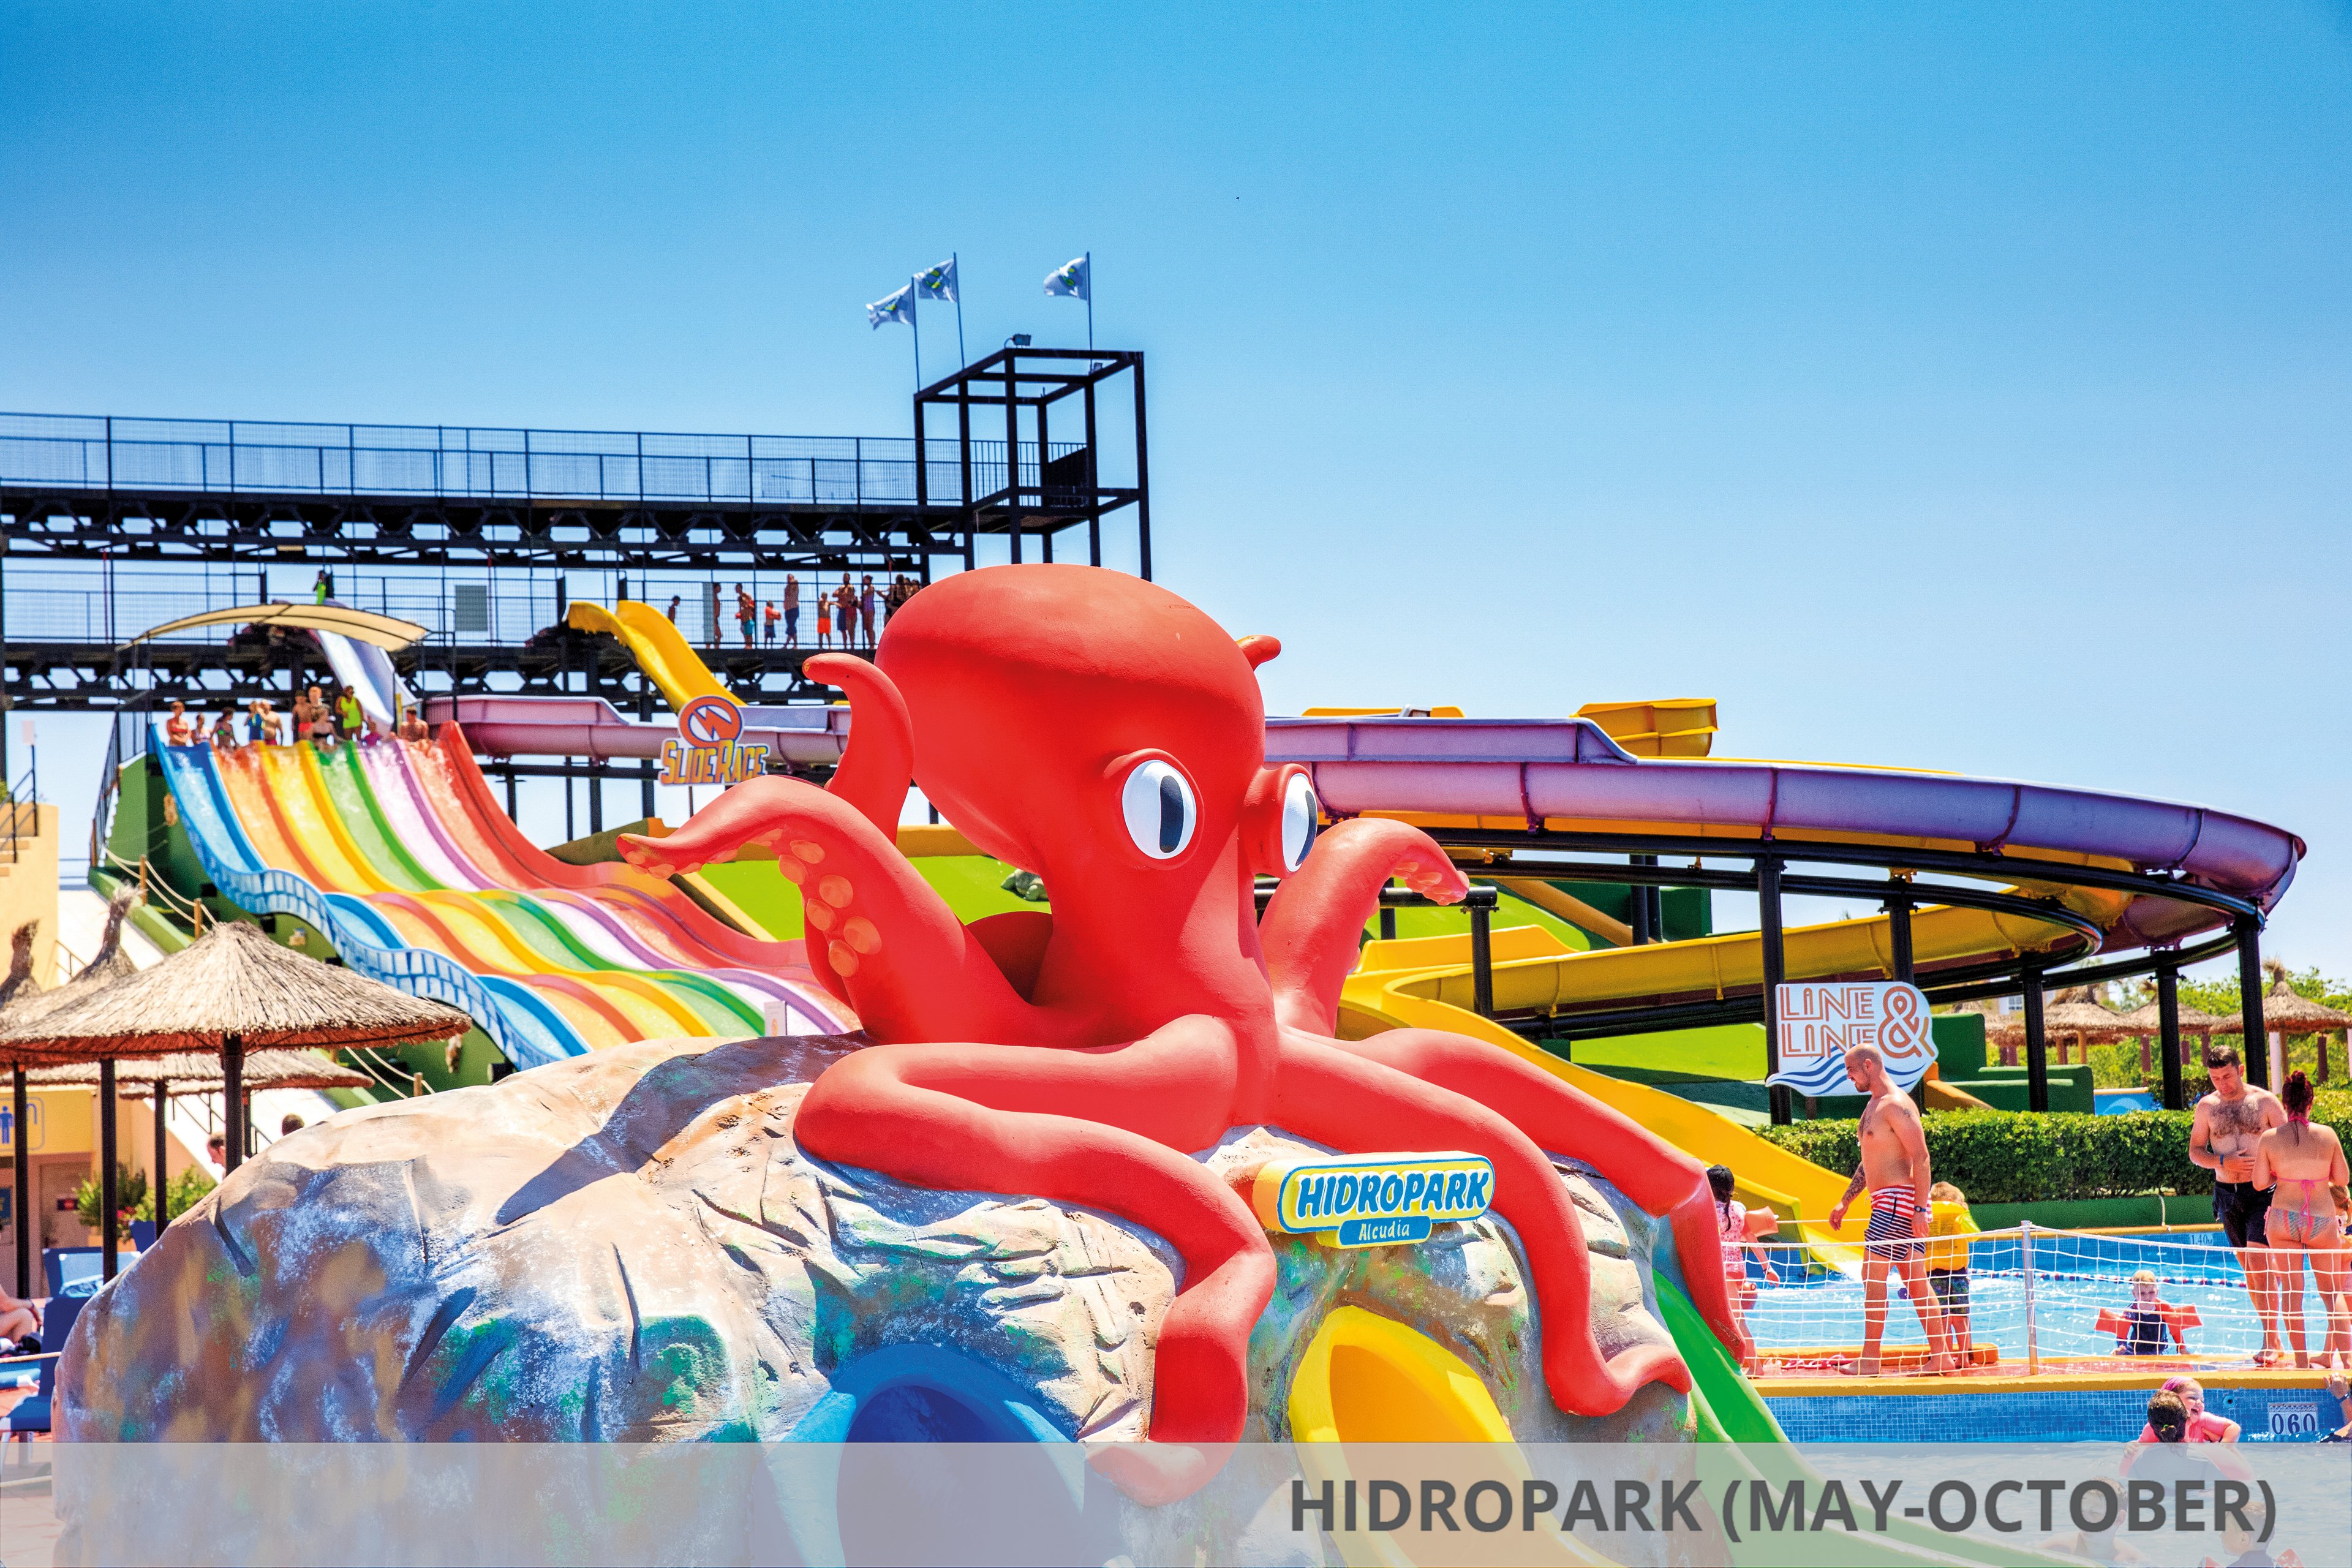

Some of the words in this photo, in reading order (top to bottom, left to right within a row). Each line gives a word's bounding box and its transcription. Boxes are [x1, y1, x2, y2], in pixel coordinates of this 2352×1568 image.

[1780, 986, 1874, 1021] LINE
[1295, 1168, 1490, 1220] HIDROPARK
[1359, 1223, 1409, 1242] Alcudia
[2272, 1413, 2315, 1434] 060
